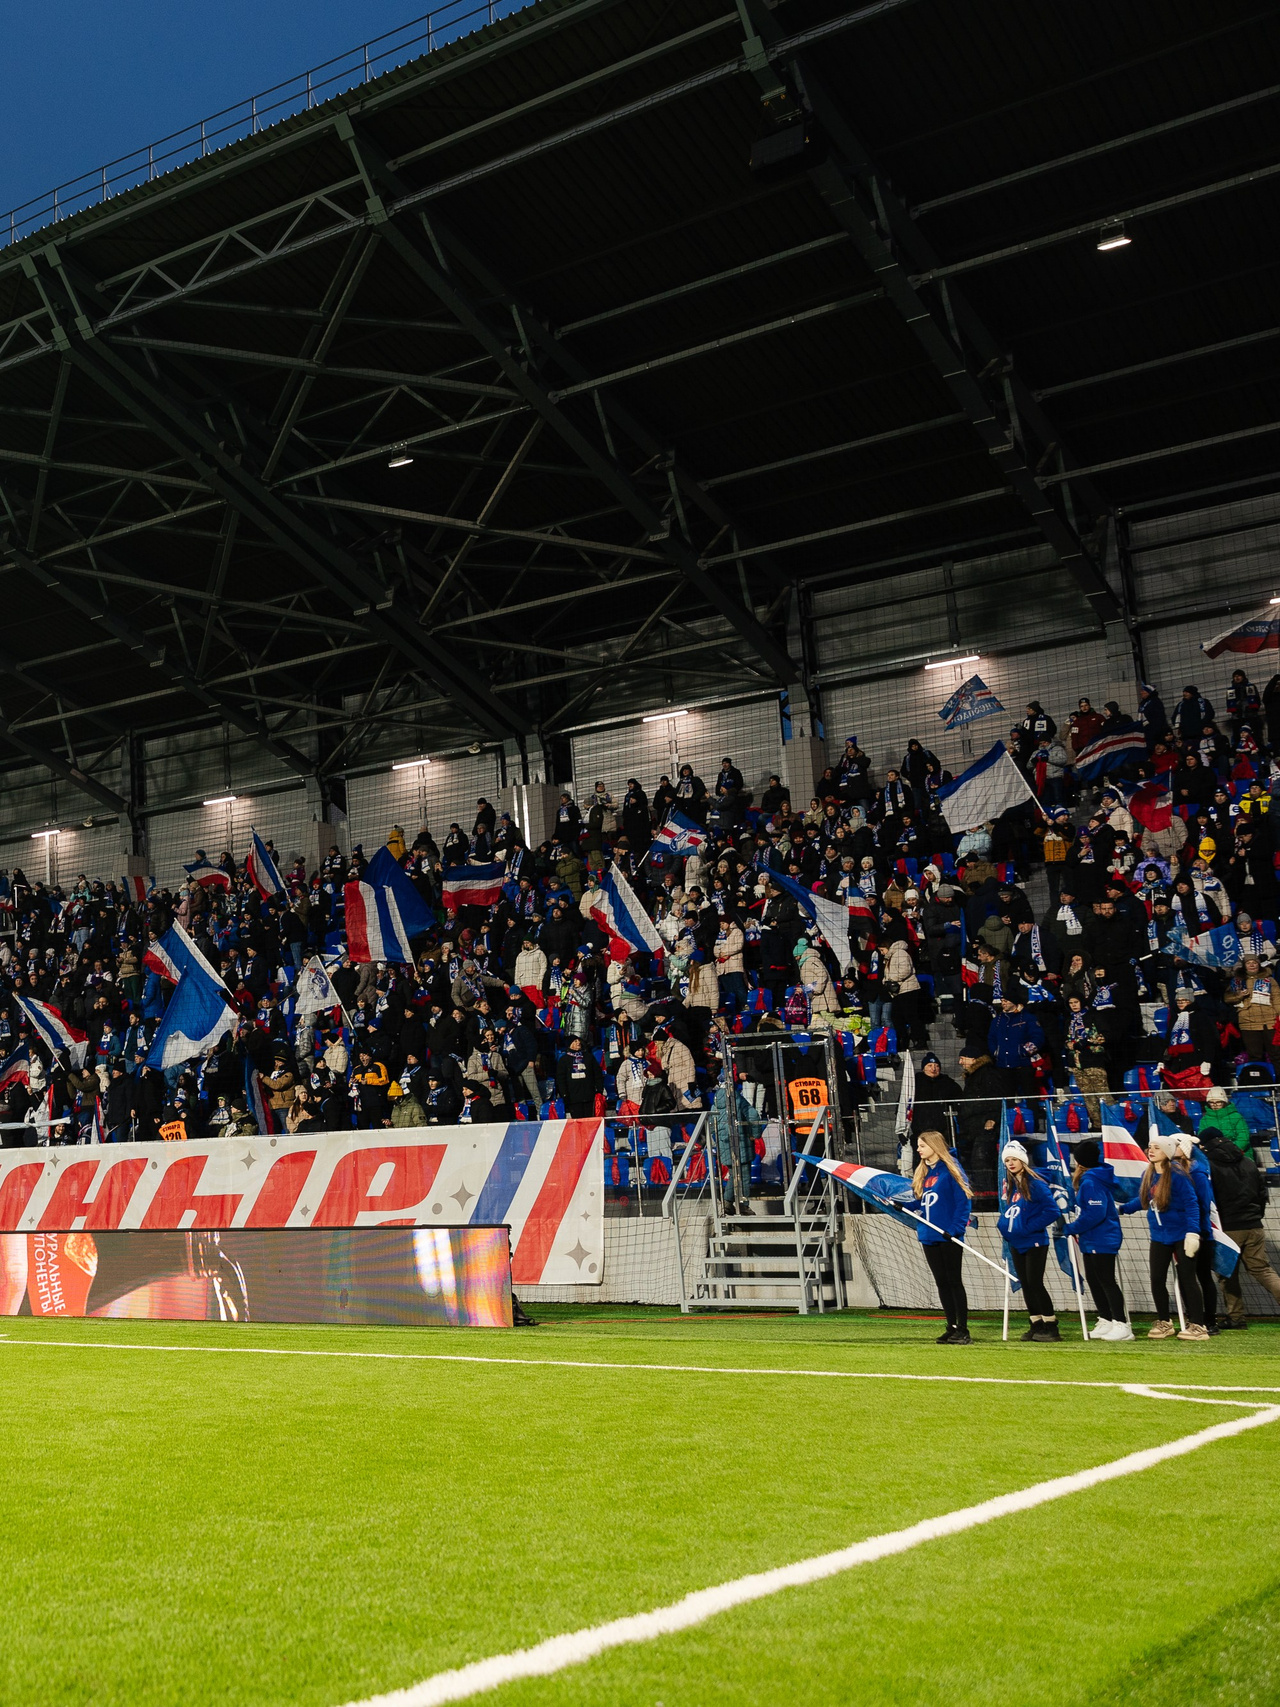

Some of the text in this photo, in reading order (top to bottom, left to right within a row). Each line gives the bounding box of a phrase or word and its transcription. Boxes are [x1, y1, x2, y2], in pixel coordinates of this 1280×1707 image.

[794, 1080, 822, 1088] СТЮАРД
[798, 1088, 821, 1106] 68
[165, 1131, 182, 1141] 120
[45, 1233, 66, 1314] УРАЛЬНЫЕ
